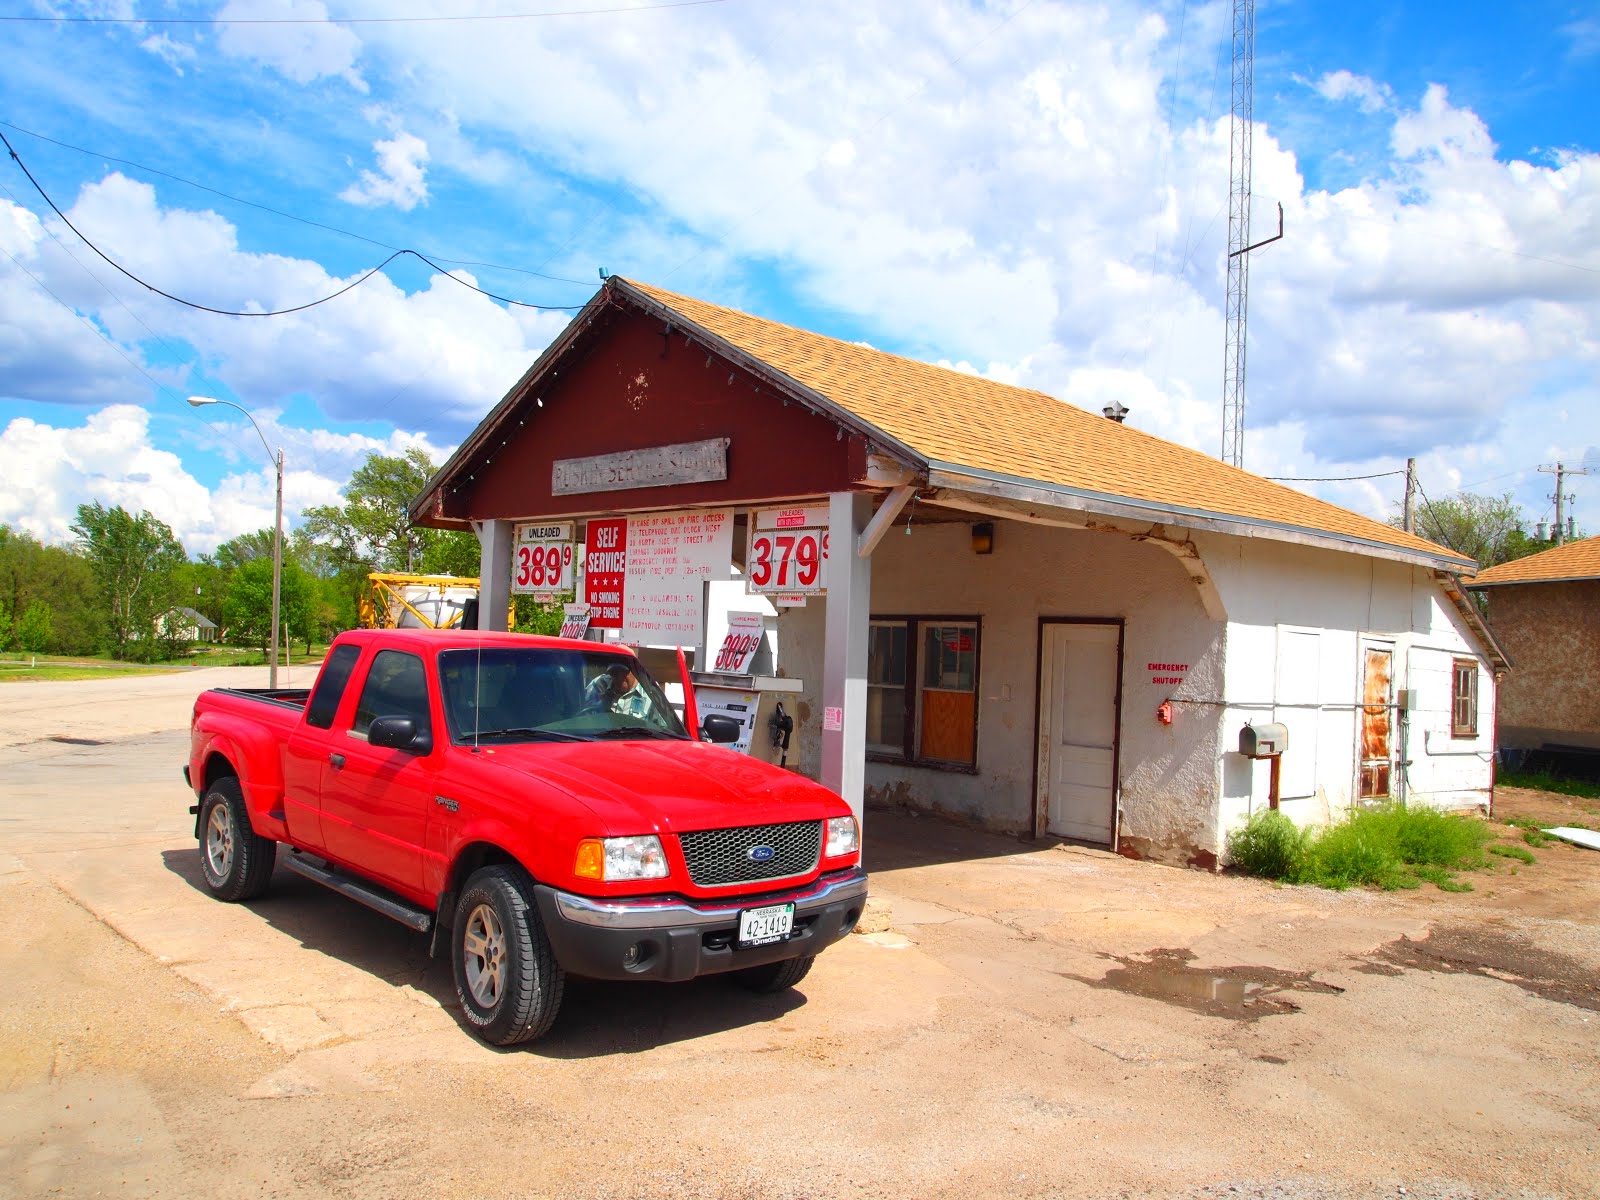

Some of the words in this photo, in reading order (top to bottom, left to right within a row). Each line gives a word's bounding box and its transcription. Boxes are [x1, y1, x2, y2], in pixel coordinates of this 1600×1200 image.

[636, 519, 650, 527] CASE
[652, 518, 659, 526] OF
[686, 516, 700, 524] FIRE
[702, 513, 725, 523] ACCESS
[528, 527, 561, 538] UNLEADED
[705, 524, 721, 533] WEST
[596, 526, 619, 549] SELF
[683, 535, 703, 544] STREET
[517, 546, 561, 586] 389
[588, 552, 626, 573] SERVICE
[752, 536, 819, 586] 379
[590, 592, 598, 604] NO
[598, 591, 620, 604] SMOKING
[590, 606, 602, 619] STOP
[602, 606, 620, 619] ENGINE
[1147, 663, 1189, 671] EMERGENCY
[755, 849, 770, 858] Ford
[756, 907, 782, 916] NEBRASKA
[746, 915, 787, 938] 42-1419
